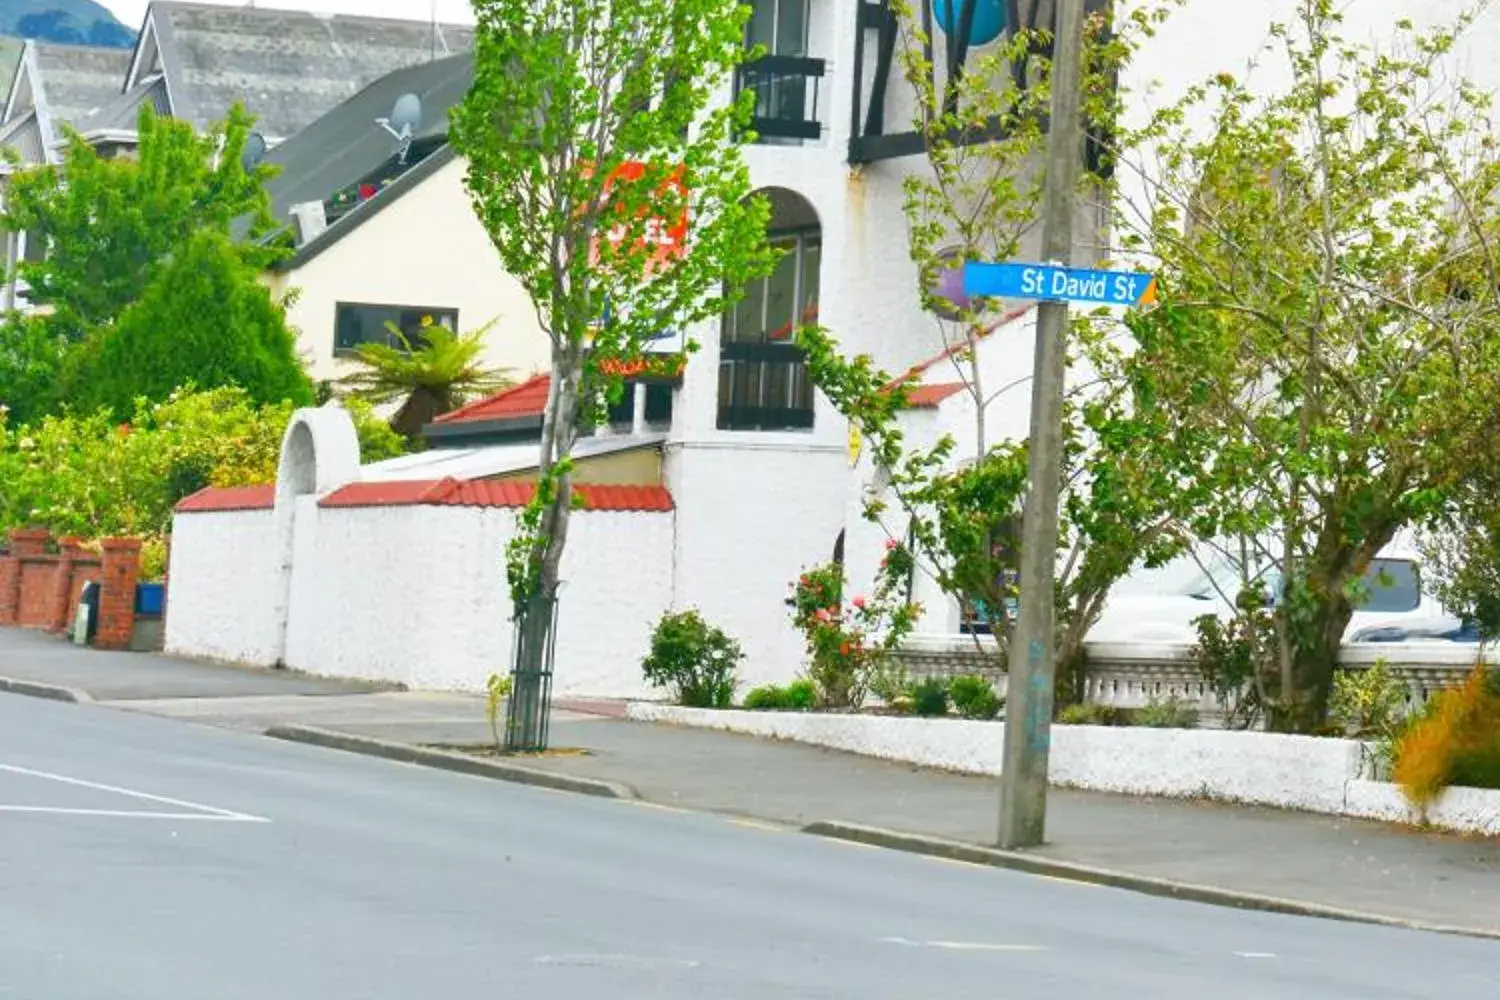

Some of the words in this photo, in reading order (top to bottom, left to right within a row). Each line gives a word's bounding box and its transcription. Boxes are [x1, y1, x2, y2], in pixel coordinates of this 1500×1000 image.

[1020, 267, 1044, 294] St
[1051, 271, 1106, 299] David
[1113, 275, 1137, 301] St
